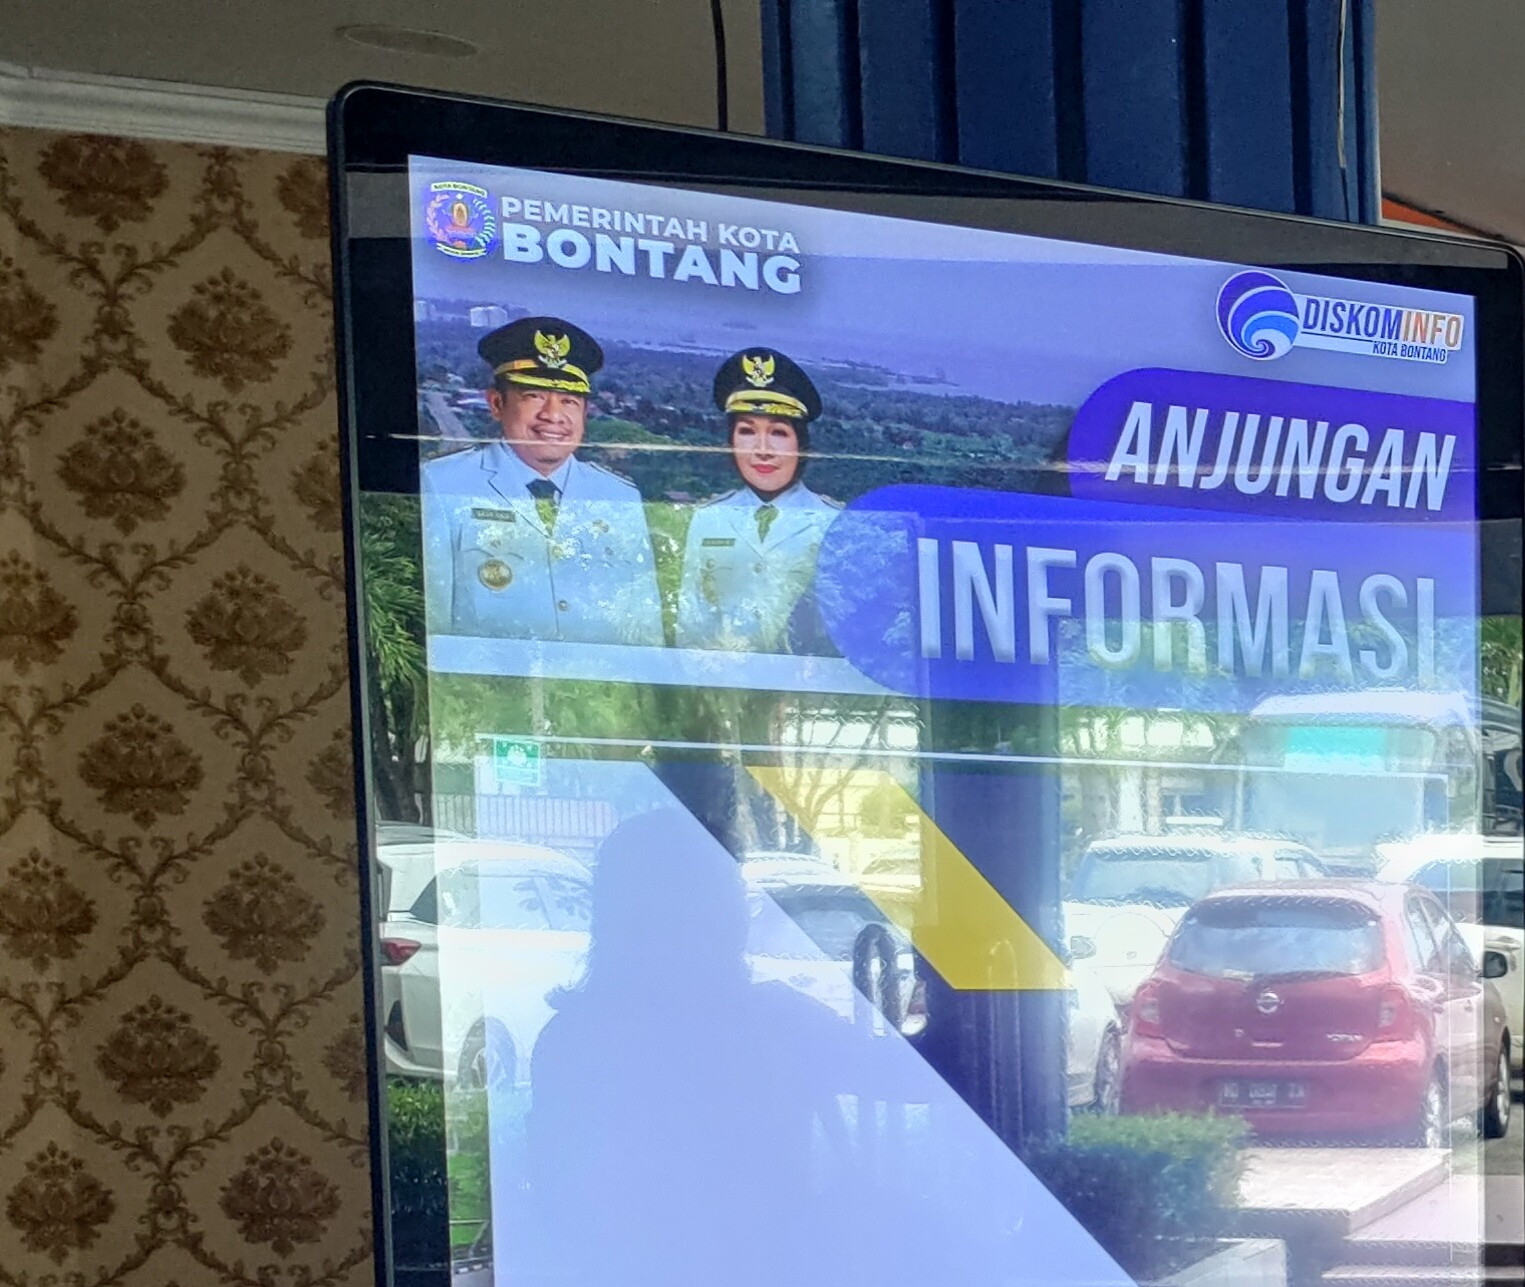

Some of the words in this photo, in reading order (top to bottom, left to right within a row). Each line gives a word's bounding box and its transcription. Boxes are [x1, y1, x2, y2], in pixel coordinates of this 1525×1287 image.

[502, 196, 707, 243] PEMERINTAH
[718, 223, 801, 253] KOTA
[503, 222, 801, 296] BONTANG
[1302, 297, 1461, 348] DISKOMINFO
[1373, 340, 1399, 356] KOTA
[1400, 344, 1446, 362] BONTANG
[1105, 401, 1456, 511] ANJUNGAN
[917, 537, 1434, 681] INFORMASI
